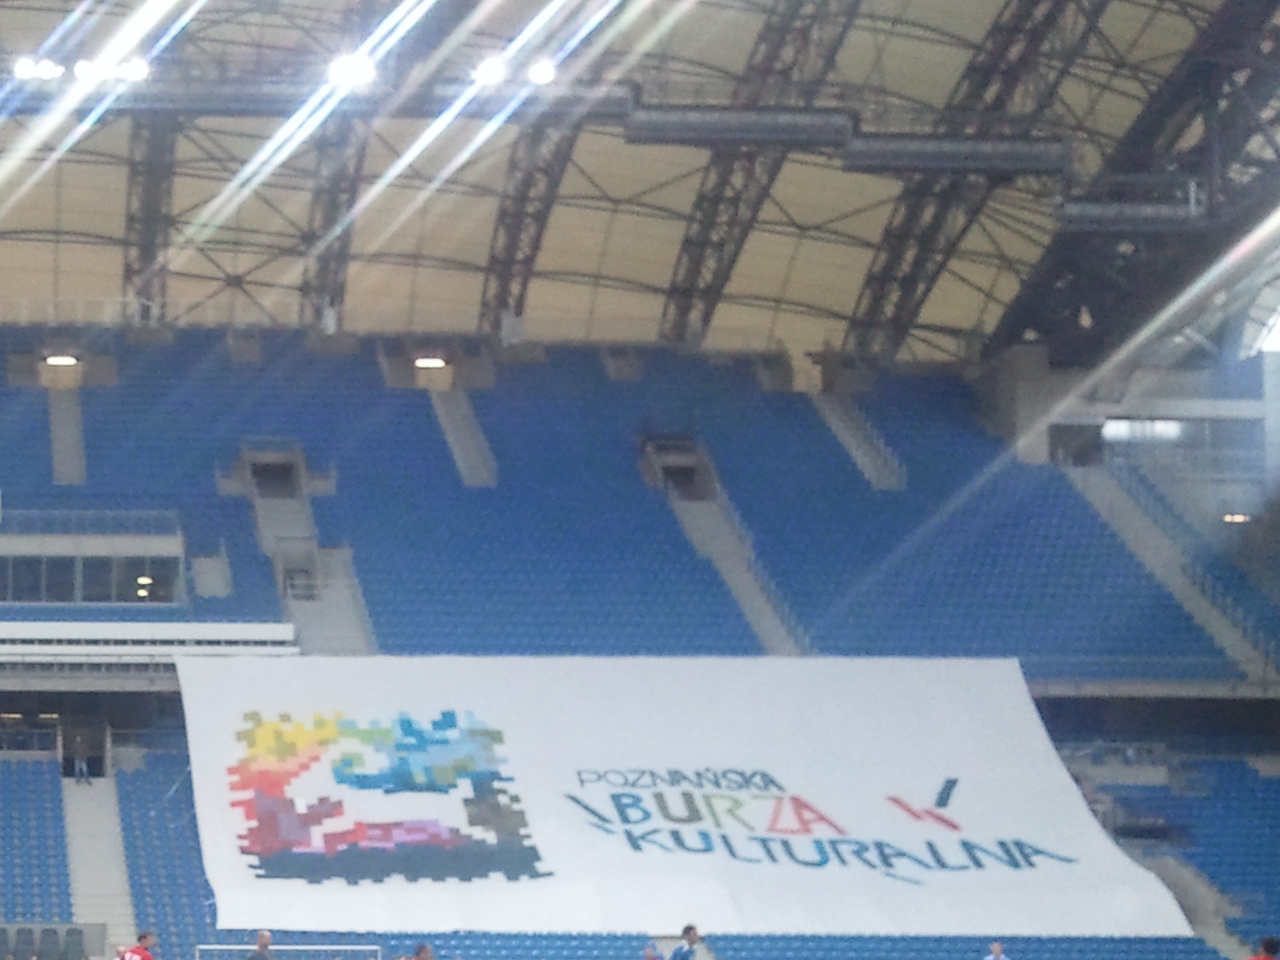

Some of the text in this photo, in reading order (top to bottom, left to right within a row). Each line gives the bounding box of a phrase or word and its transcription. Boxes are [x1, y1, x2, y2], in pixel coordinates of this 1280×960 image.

[576, 766, 786, 793] POZNAŃSKA
[610, 792, 848, 837] BURZA
[623, 828, 1078, 871] KULTURALNA
